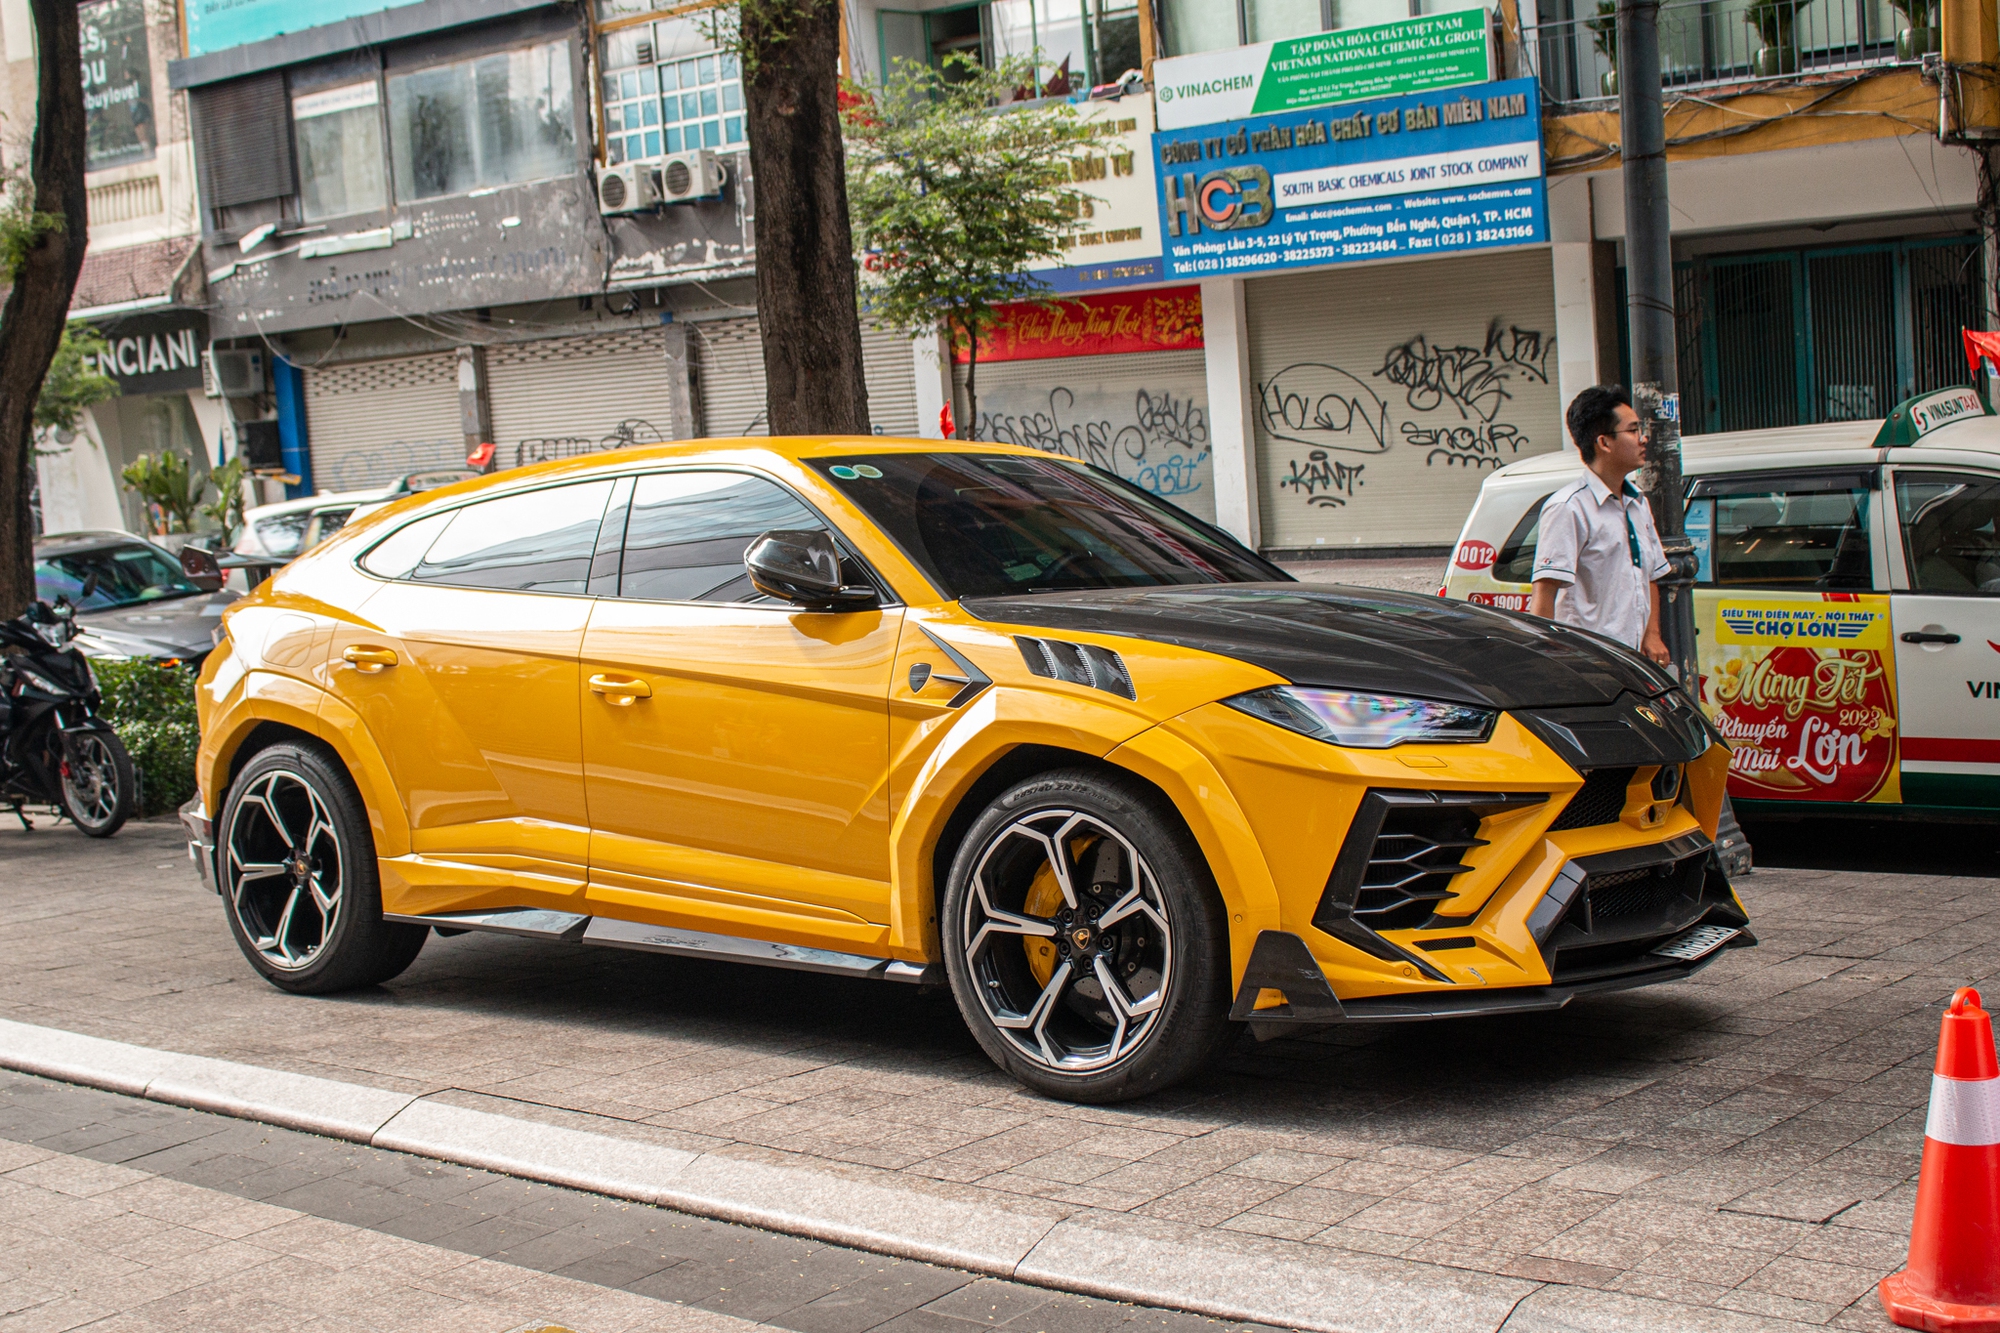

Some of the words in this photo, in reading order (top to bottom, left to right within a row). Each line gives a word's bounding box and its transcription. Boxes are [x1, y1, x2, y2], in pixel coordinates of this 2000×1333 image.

[1271, 55, 1322, 72] VIETNAM
[1324, 46, 1380, 64] NATIONAL
[1382, 35, 1443, 55] CHEMICAL
[1445, 29, 1486, 44] GROUP
[1290, 42, 1312, 56] TẬP
[1314, 36, 1344, 52] ĐOÀN
[1347, 31, 1371, 46] HÓA
[1372, 26, 1404, 42] CHẤT
[1406, 22, 1434, 36] VIỆT
[1436, 17, 1463, 32] NAM
[1176, 74, 1253, 99] VINACHEM
[1161, 139, 1201, 165] CÔNG
[1204, 137, 1223, 159] TY
[1252, 124, 1293, 153] PHẦN
[1295, 119, 1328, 147] HÓA
[1330, 110, 1373, 142] CHẤT
[1376, 108, 1402, 135] CƠ
[1405, 102, 1439, 132] BẢN
[1443, 94, 1484, 126] MIỀN
[1487, 93, 1527, 120] NAM
[1282, 180, 1314, 197] SOUTH
[1318, 176, 1346, 193] BASIC
[1349, 170, 1405, 189] CHEMICALS
[1410, 166, 1436, 181] JOINT
[1440, 162, 1474, 178] STOCK
[1478, 154, 1528, 173] COMPANY
[1285, 210, 1309, 222] Email:
[1310, 203, 1392, 222] sbcc@sochemvn.com
[1404, 194, 1440, 210] Website:
[1514, 187, 1532, 197] com
[1172, 244, 1190, 258] Văn
[1193, 238, 1226, 256] Phòng:
[1228, 236, 1246, 250] Lầu
[1247, 236, 1266, 249] 3-5,
[1268, 235, 1280, 246] 22
[1282, 232, 1293, 246] Lý
[1294, 230, 1308, 246] Tự
[1310, 228, 1342, 244] Trọng,
[1343, 223, 1384, 239] Phường
[1386, 219, 1407, 234] Bến
[1410, 216, 1440, 233] Nghé,
[1483, 211, 1502, 224] TP.
[1504, 206, 1532, 222] HCM
[1226, 250, 1278, 268] 38296620
[1284, 245, 1335, 262] 38225373
[1342, 239, 1398, 257] 38223484
[1409, 236, 1433, 250] Fax:
[1476, 224, 1534, 243] 38243166
[1016, 311, 1049, 344] Chúc
[1043, 309, 1085, 347] Mừng
[1460, 546, 1495, 565] 0012
[1722, 608, 1744, 618] SIÊU
[1746, 610, 1763, 621] THỊ
[1766, 608, 1790, 622] ĐIỆN
[1793, 609, 1815, 620] MÁY
[1826, 610, 1846, 622] NỘI
[1848, 610, 1875, 622] THẤT
[1755, 620, 1795, 640] CHỢ
[1797, 618, 1837, 638] LỚN
[1715, 657, 1833, 722] Mừng
[1814, 651, 1884, 705] Tết
[1716, 711, 1790, 746] Khuyến
[1839, 708, 1882, 730] 2023
[1732, 746, 1781, 771] Mãi
[1787, 715, 1868, 784] Lớn
